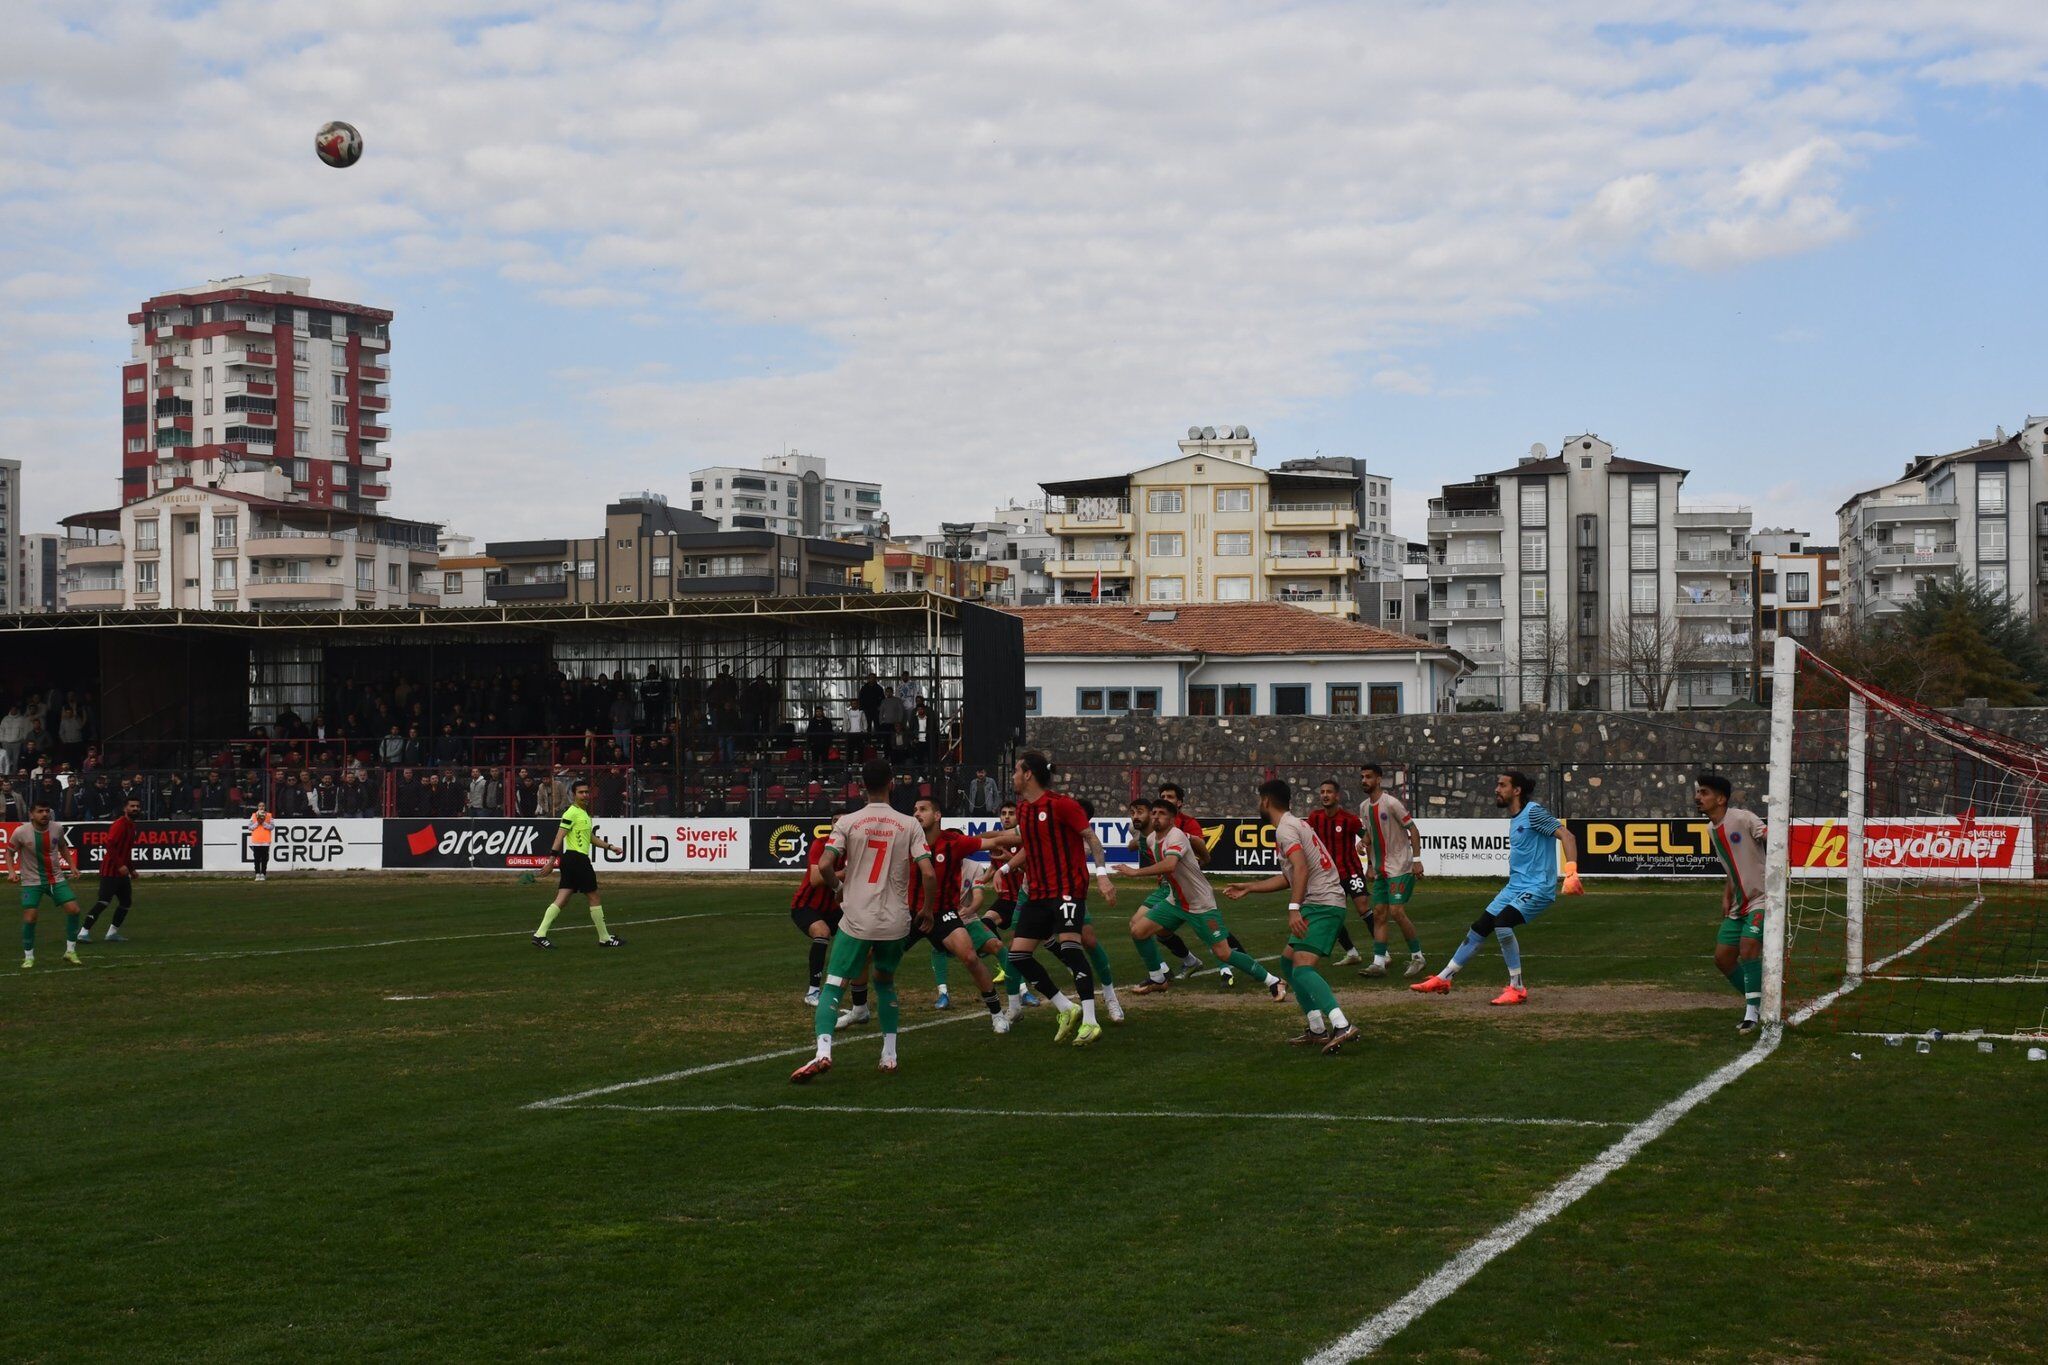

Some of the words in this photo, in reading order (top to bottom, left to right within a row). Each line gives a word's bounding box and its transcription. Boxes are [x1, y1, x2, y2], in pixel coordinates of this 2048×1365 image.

[134, 830, 197, 847] ABATAŞ
[274, 825, 342, 843] ROZA
[676, 827, 738, 842] Siverek
[438, 826, 539, 861] arçelik
[1420, 836, 1467, 852] TINTAŞ
[273, 845, 343, 862] GRUP
[686, 844, 727, 862] Bayii
[867, 839, 888, 884] 7
[1440, 853, 1469, 861] MERMER
[1349, 877, 1365, 891] 36
[1059, 902, 1077, 919] 17
